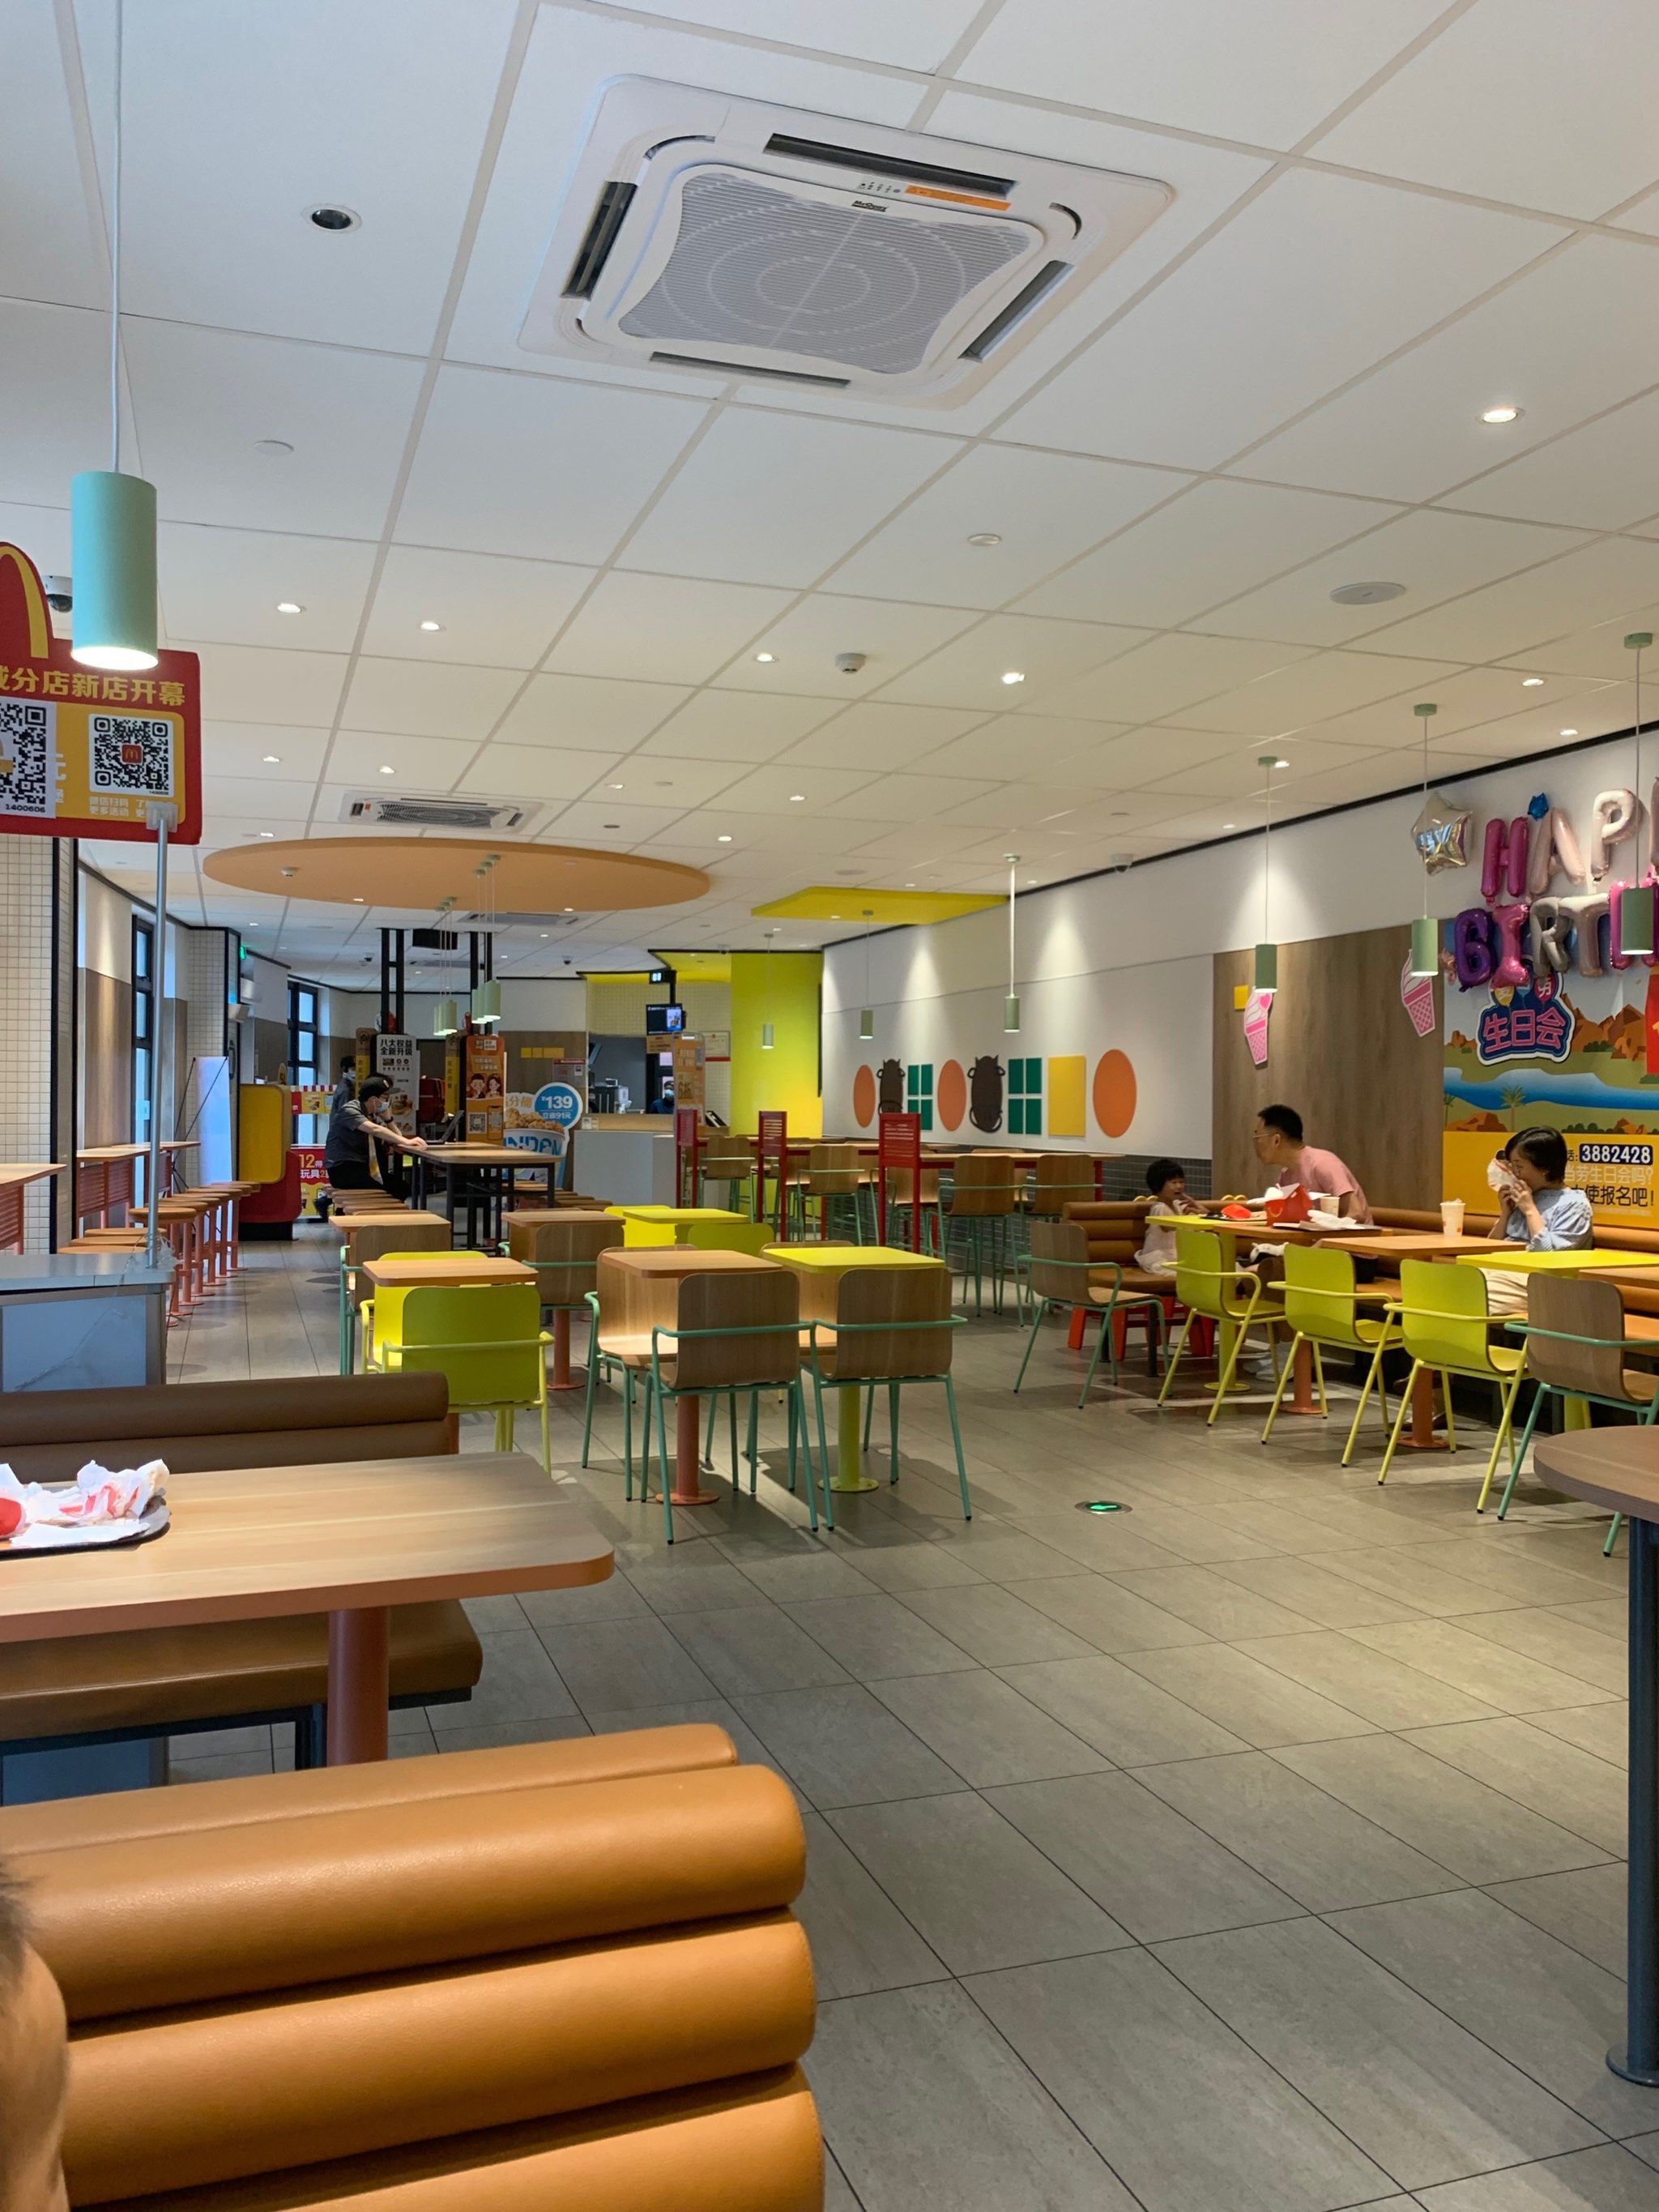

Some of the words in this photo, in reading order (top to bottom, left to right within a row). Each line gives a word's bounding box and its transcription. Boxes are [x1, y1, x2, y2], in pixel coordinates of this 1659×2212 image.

[5, 804, 46, 813] 1400606
[1481, 776, 1659, 904] HAP
[1483, 1007, 1566, 1053] 生日会
[541, 1095, 574, 1109] ¥139
[1582, 1145, 1651, 1164] 3882428
[1571, 1185, 1654, 1207] 使报名吧!
